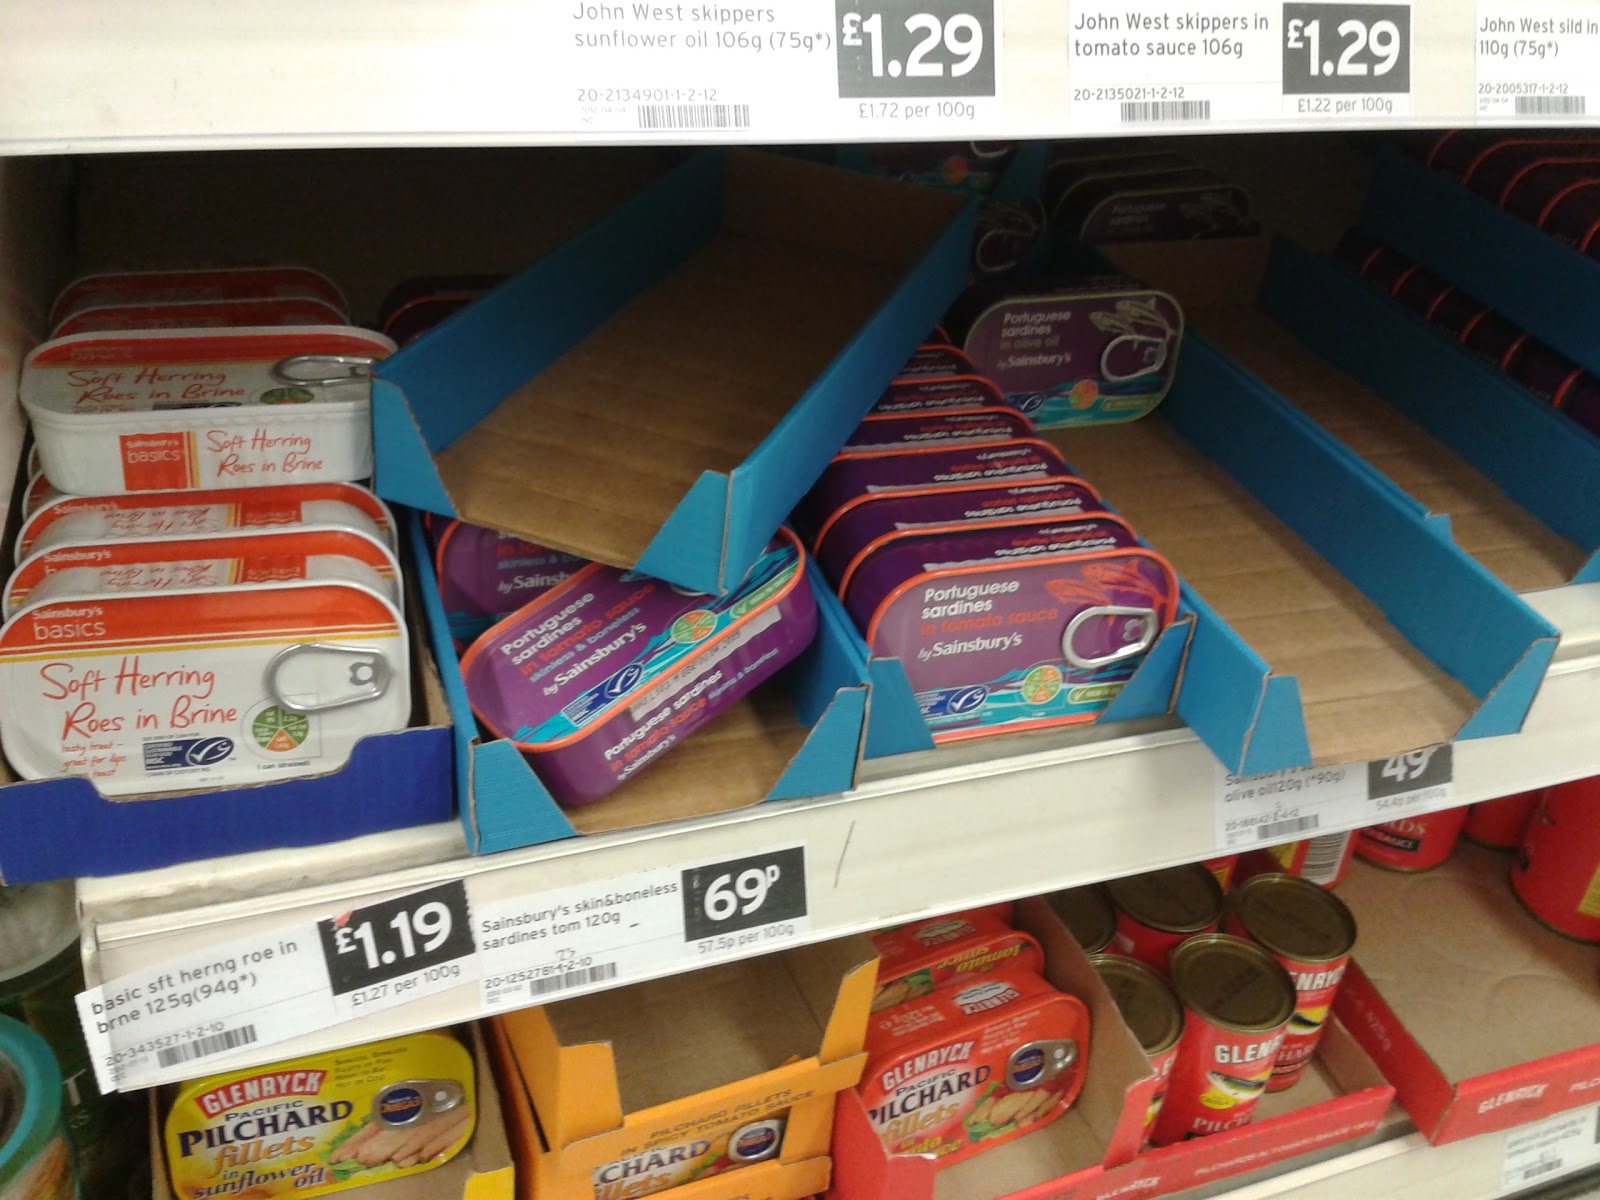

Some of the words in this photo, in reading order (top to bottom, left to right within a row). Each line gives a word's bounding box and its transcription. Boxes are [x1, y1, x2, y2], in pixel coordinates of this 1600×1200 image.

[573, 2, 626, 21] John
[632, 2, 684, 21] West
[692, 3, 775, 25] skippers
[1074, 13, 1119, 31] John
[1126, 13, 1170, 31] West
[1176, 13, 1247, 34] skippers
[1254, 14, 1269, 31] in
[1480, 16, 1516, 33] John
[1520, 17, 1554, 34] West
[1559, 18, 1583, 34] sild
[1587, 19, 1599, 35] in
[574, 30, 680, 48] sunflower
[685, 30, 708, 48] oil
[714, 32, 763, 51] 106g
[842, 13, 984, 77] £1.29
[1074, 38, 1140, 57] tomato
[1146, 40, 1197, 56] sauce
[1202, 38, 1243, 59] 106g
[1287, 19, 1401, 77] £1.29
[1479, 39, 1509, 59] 110g
[578, 88, 718, 102] 20-2134901-1-2-12
[1073, 86, 1186, 101] 20-2135021-1-2-12
[1297, 98, 1331, 114] £1.22
[1336, 100, 1358, 115] per
[1361, 98, 1393, 115] 100g
[859, 103, 899, 119] £1.72
[904, 105, 931, 120] per
[936, 102, 976, 120] 100g
[1001, 325, 1052, 338] sardines
[1003, 311, 1072, 325] Portuguese
[1007, 352, 1073, 369] Sainsbury's
[67, 369, 122, 388] Soft
[134, 367, 227, 387] Herring
[76, 386, 140, 405] Roes
[149, 389, 170, 400] in
[181, 383, 246, 400] Brine
[206, 429, 246, 453] Soft
[251, 428, 312, 454] Herring
[127, 449, 181, 464] basics
[217, 454, 256, 478] Roes
[262, 459, 276, 472] in
[282, 451, 324, 473] Brine
[498, 580, 514, 594] by
[923, 579, 1021, 605] Portuguese
[32, 605, 104, 620] Sainsbury's
[500, 591, 596, 657] Portuguese
[920, 621, 937, 637] in
[939, 612, 1004, 633] tomato
[1005, 607, 1059, 625] sauce
[921, 600, 994, 620] sardines
[34, 619, 107, 642] basics
[511, 616, 584, 666] sardines
[519, 660, 537, 676] in
[538, 617, 603, 664] tomato
[604, 583, 656, 622] sauce
[529, 648, 573, 685] skinless
[574, 639, 587, 653] &
[587, 605, 642, 645] boneless
[542, 681, 561, 697] by
[554, 622, 648, 688] Sainsbury's
[917, 646, 933, 661] by
[931, 630, 1023, 658] Sainsbury's
[39, 661, 106, 701] Soft
[115, 655, 216, 700] Herring
[62, 700, 125, 741] Roes
[136, 706, 159, 730] in
[168, 695, 238, 731] Brine
[604, 704, 672, 761] Portuguese
[672, 668, 724, 711] sardines
[622, 732, 677, 777] Sainsbury's
[482, 904, 571, 934] Sainsbury's
[574, 881, 679, 915] skin&boneless
[704, 864, 781, 922] 69p
[333, 901, 454, 970] £1.19
[482, 924, 548, 951] sardines
[551, 918, 582, 936] tom
[585, 910, 621, 930] 120g
[697, 934, 737, 955] 57.5p
[738, 929, 760, 950] per
[762, 922, 796, 942] 100g
[91, 985, 143, 1016] basic
[147, 975, 175, 995] sft
[179, 957, 237, 992] herng
[242, 947, 275, 967] roe
[280, 940, 298, 956] in
[352, 984, 390, 1007] £1.27
[393, 976, 419, 1000] per
[422, 963, 462, 986] 100g
[96, 1008, 142, 1035] brne
[882, 1041, 976, 1092] GLENRYCK
[203, 1071, 323, 1115] GLENRYCK
[896, 1068, 957, 1097] PACIFIC
[224, 1100, 305, 1122] PACIFIC
[650, 1109, 728, 1139] PILCHARD
[734, 1089, 792, 1112] FILLETS
[882, 1102, 960, 1142] fillets
[178, 1099, 355, 1159] PILCHARD
[206, 1134, 316, 1180] fillets
[599, 1140, 711, 1184] CHARD
[194, 1162, 317, 1200] sunflower
[222, 1169, 240, 1182] in
[293, 1166, 326, 1190] oil
